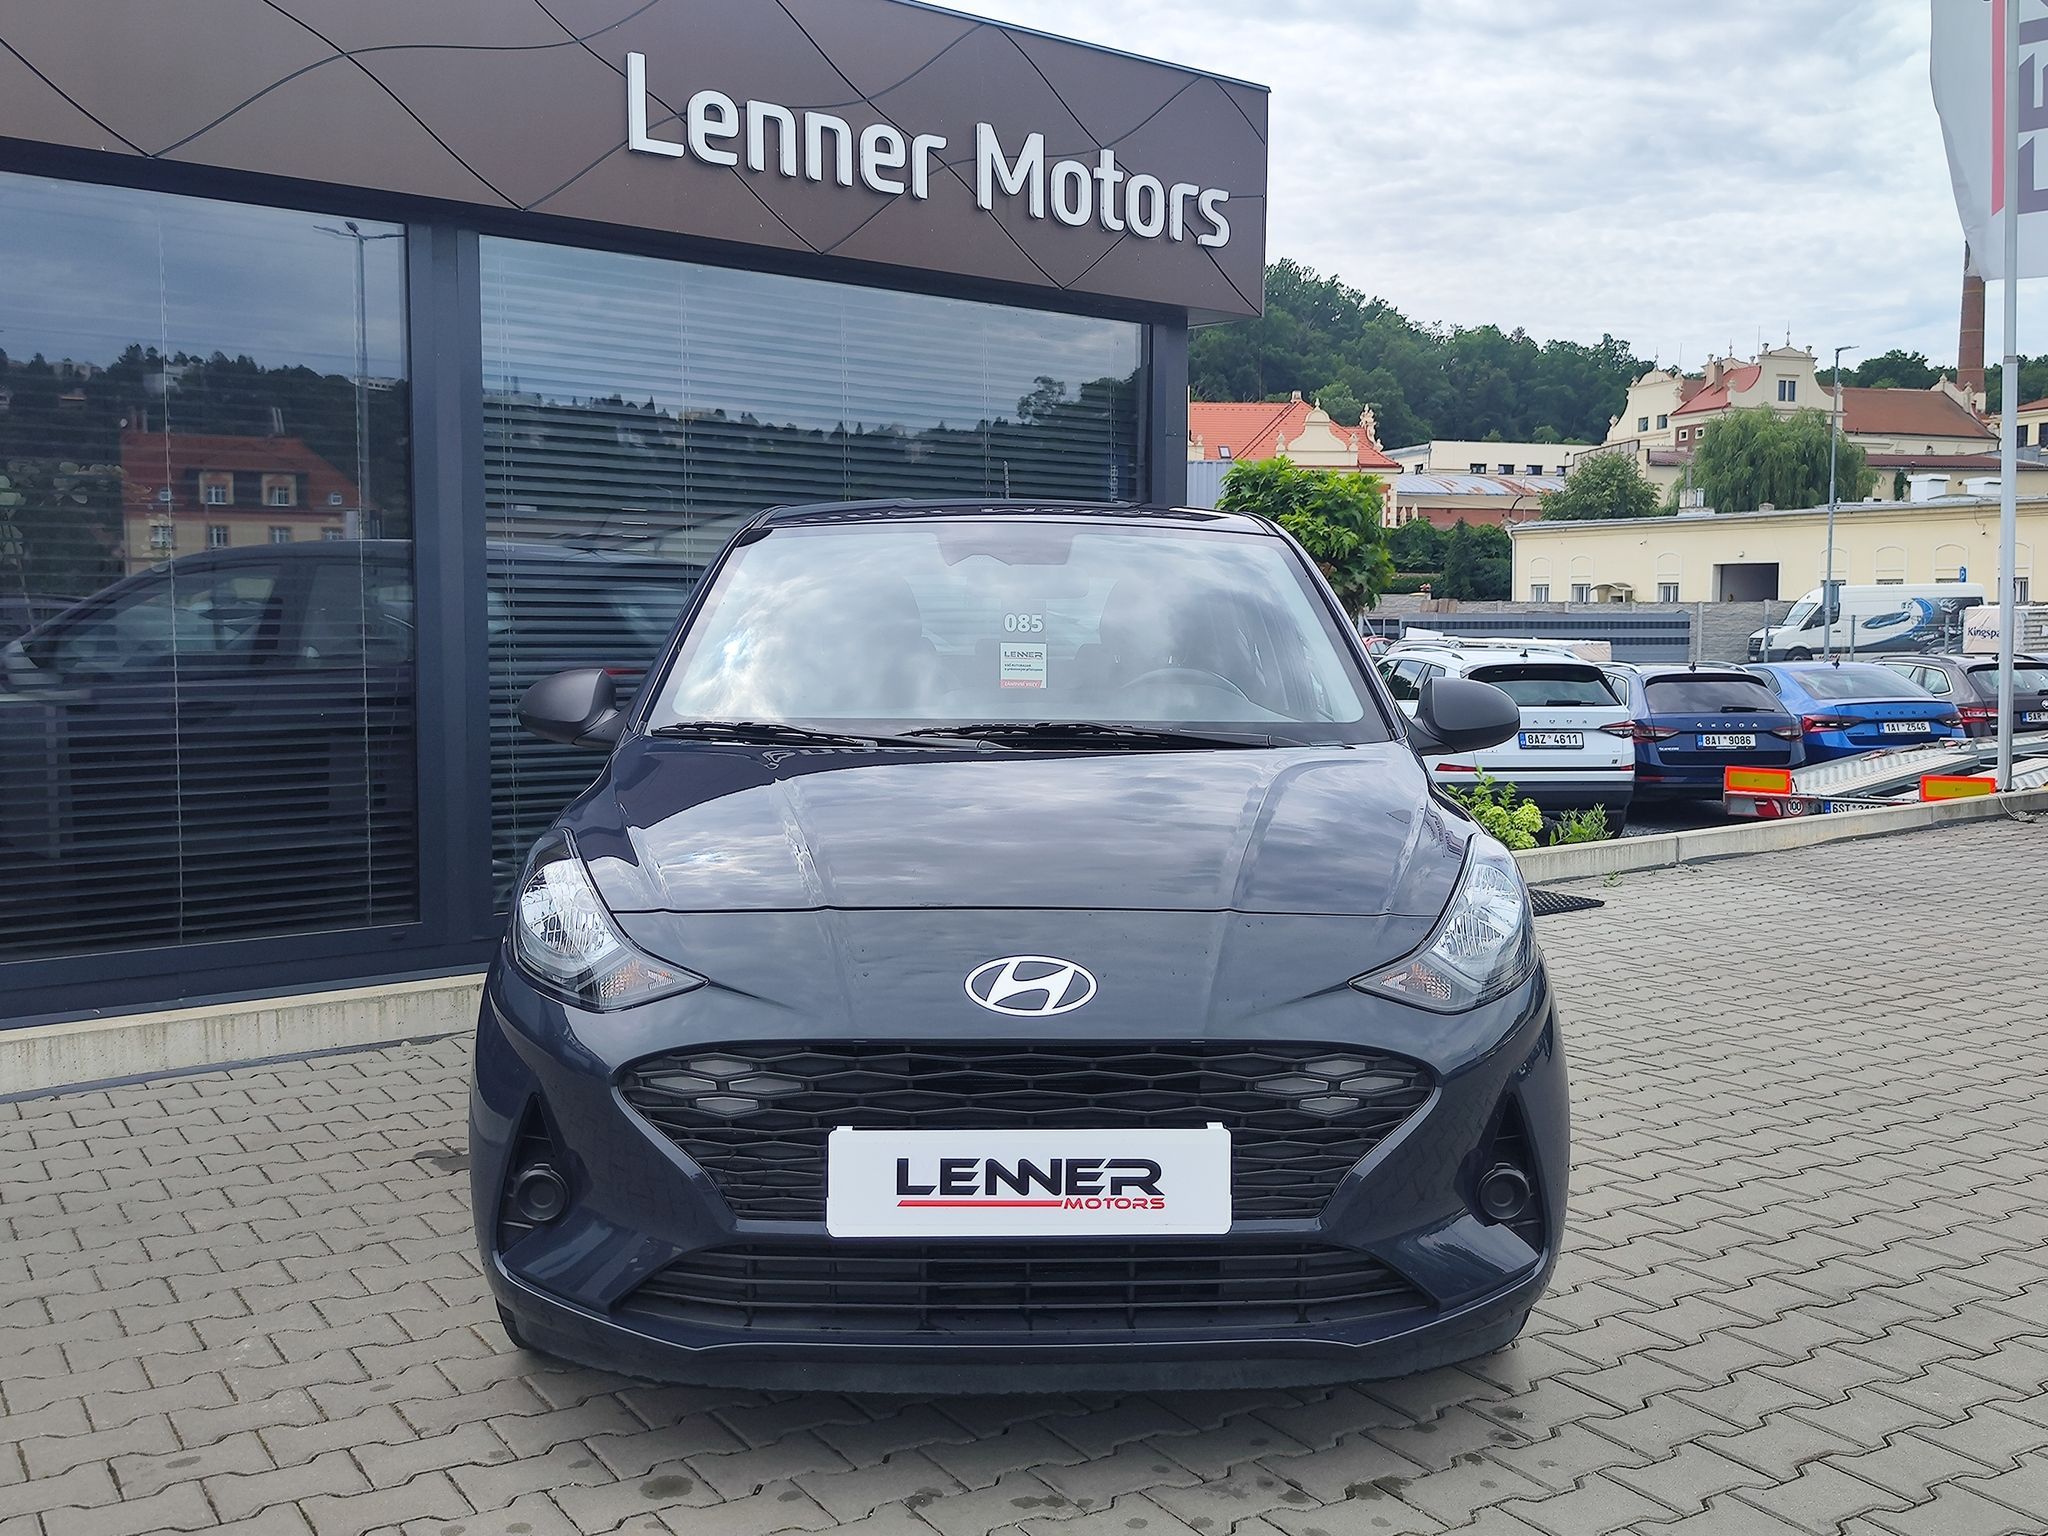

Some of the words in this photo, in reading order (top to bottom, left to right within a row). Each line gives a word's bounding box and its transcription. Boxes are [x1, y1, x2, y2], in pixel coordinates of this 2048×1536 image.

[626, 51, 949, 200] Lenner
[975, 122, 1232, 248] Motors
[1003, 613, 1044, 633] 085
[1967, 626, 2000, 639] Kingspa
[1885, 723, 1900, 732] 1AI
[1906, 722, 1927, 731] 2546
[1527, 734, 1546, 744] 8AZ
[1553, 734, 1578, 744] 4611
[1705, 736, 1721, 745] 8AI
[1728, 736, 1752, 745] 9086
[1789, 801, 1801, 811] 100
[1832, 803, 1850, 813] 6ST
[896, 1157, 1165, 1196] LENNER
[1063, 1197, 1166, 1209] MOTORS
